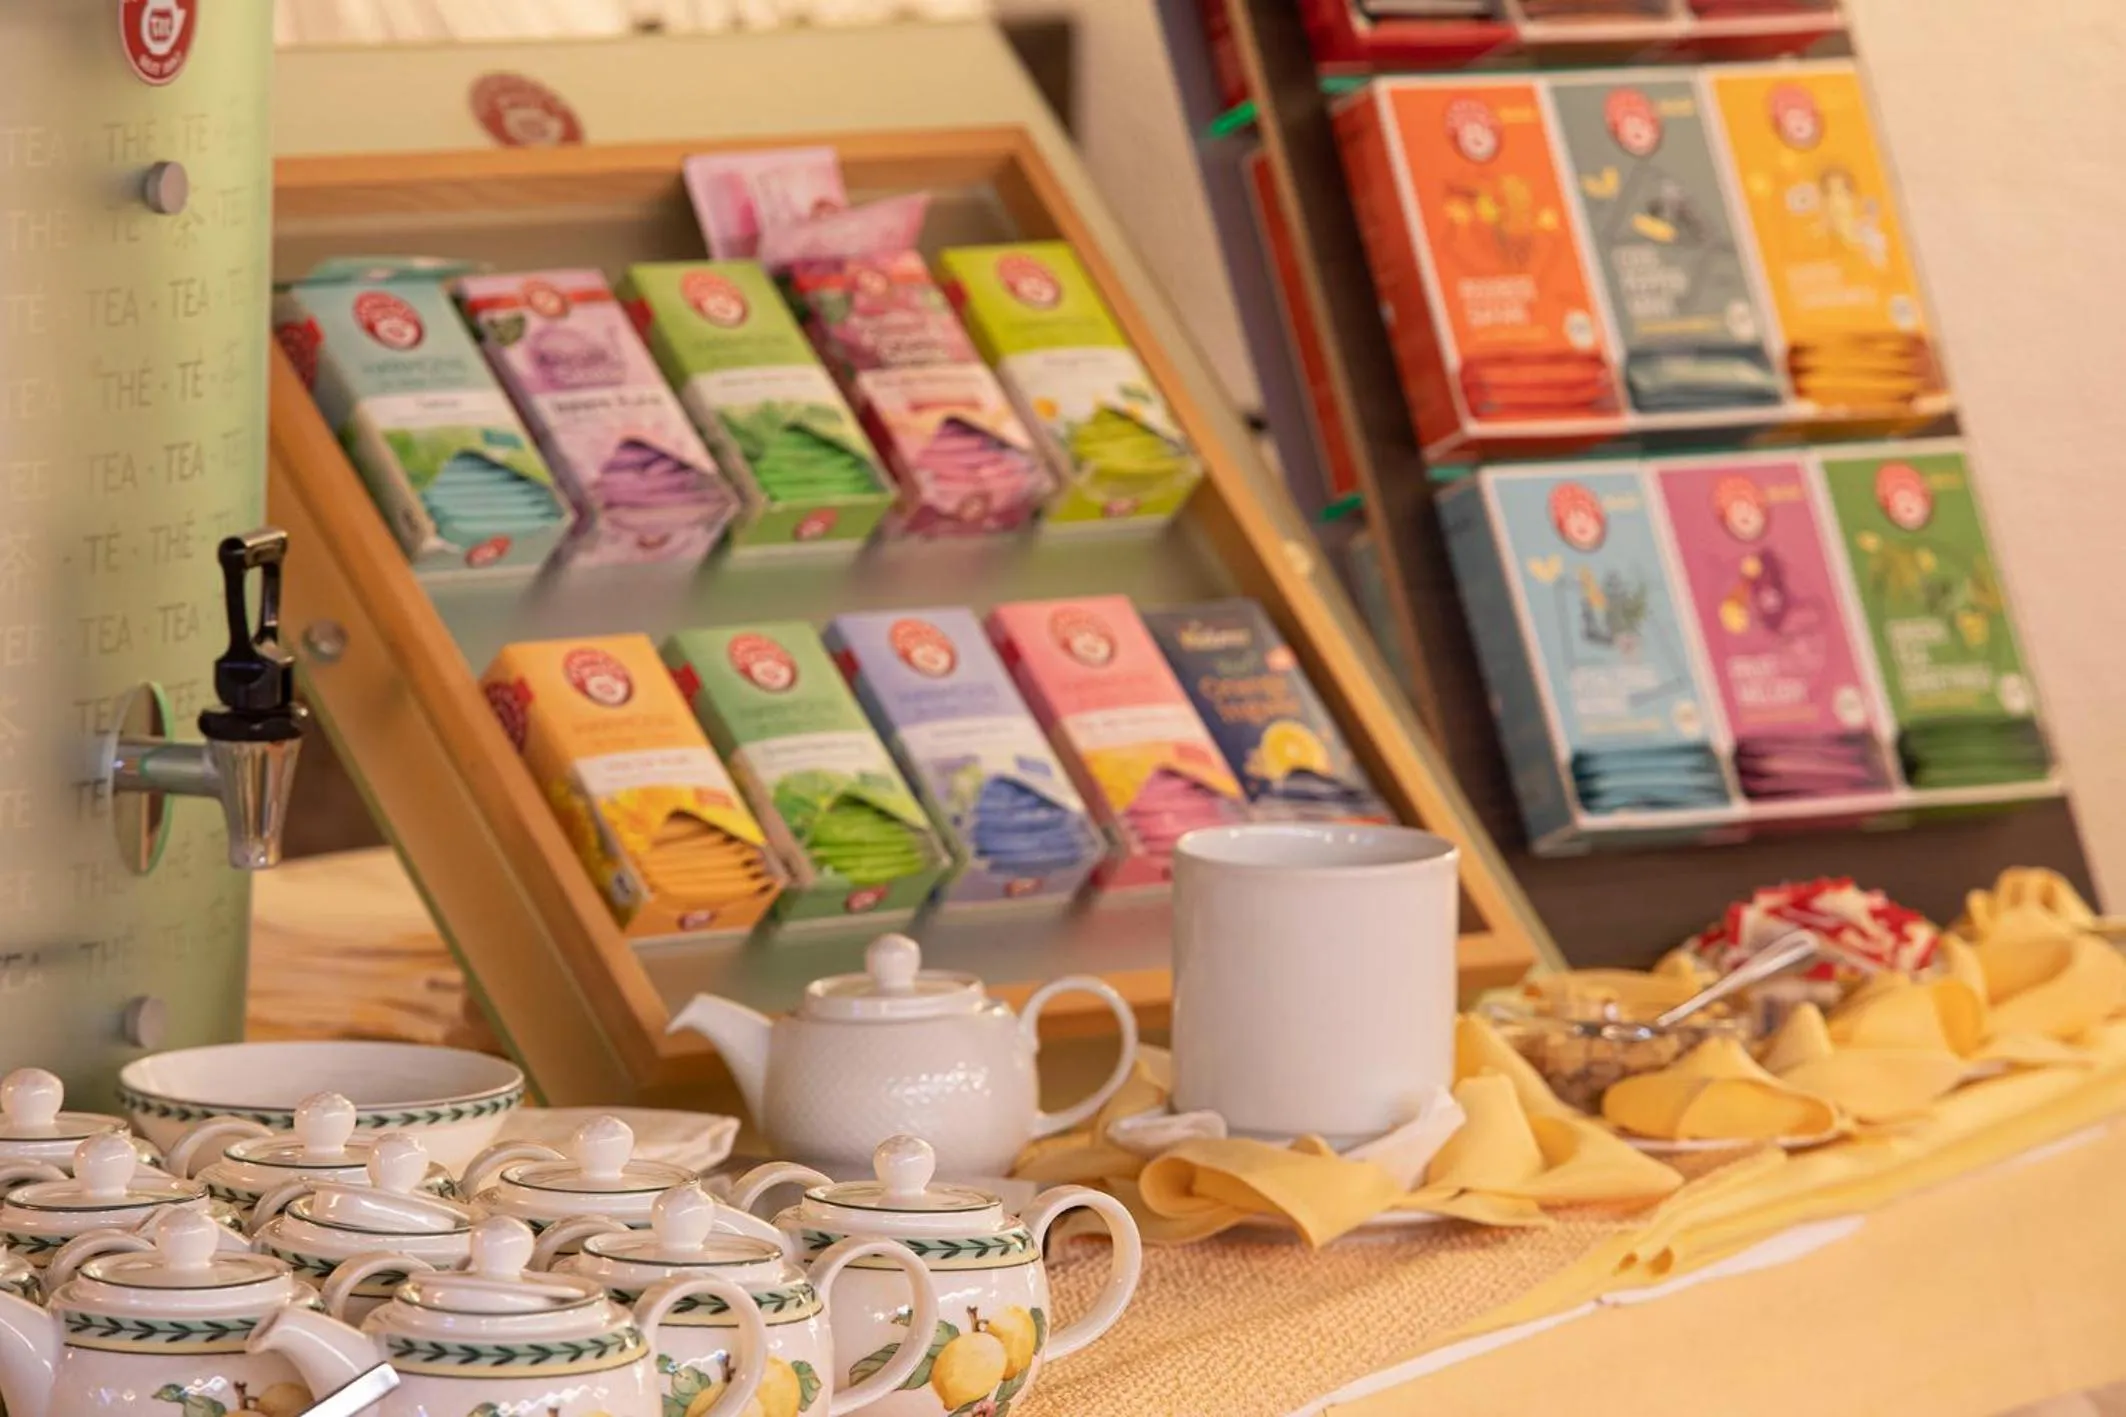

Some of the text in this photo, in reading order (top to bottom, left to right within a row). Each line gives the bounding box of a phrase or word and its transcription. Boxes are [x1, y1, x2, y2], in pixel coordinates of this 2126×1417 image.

[84, 286, 140, 330] TEA
[168, 276, 211, 319] TEA
[98, 355, 153, 411] THÉ
[84, 450, 139, 496] TEA
[163, 438, 206, 484] TEA
[82, 521, 122, 576] TÉ
[148, 508, 196, 566] THÉ
[76, 610, 134, 658] TEA
[156, 601, 201, 645] TEA
